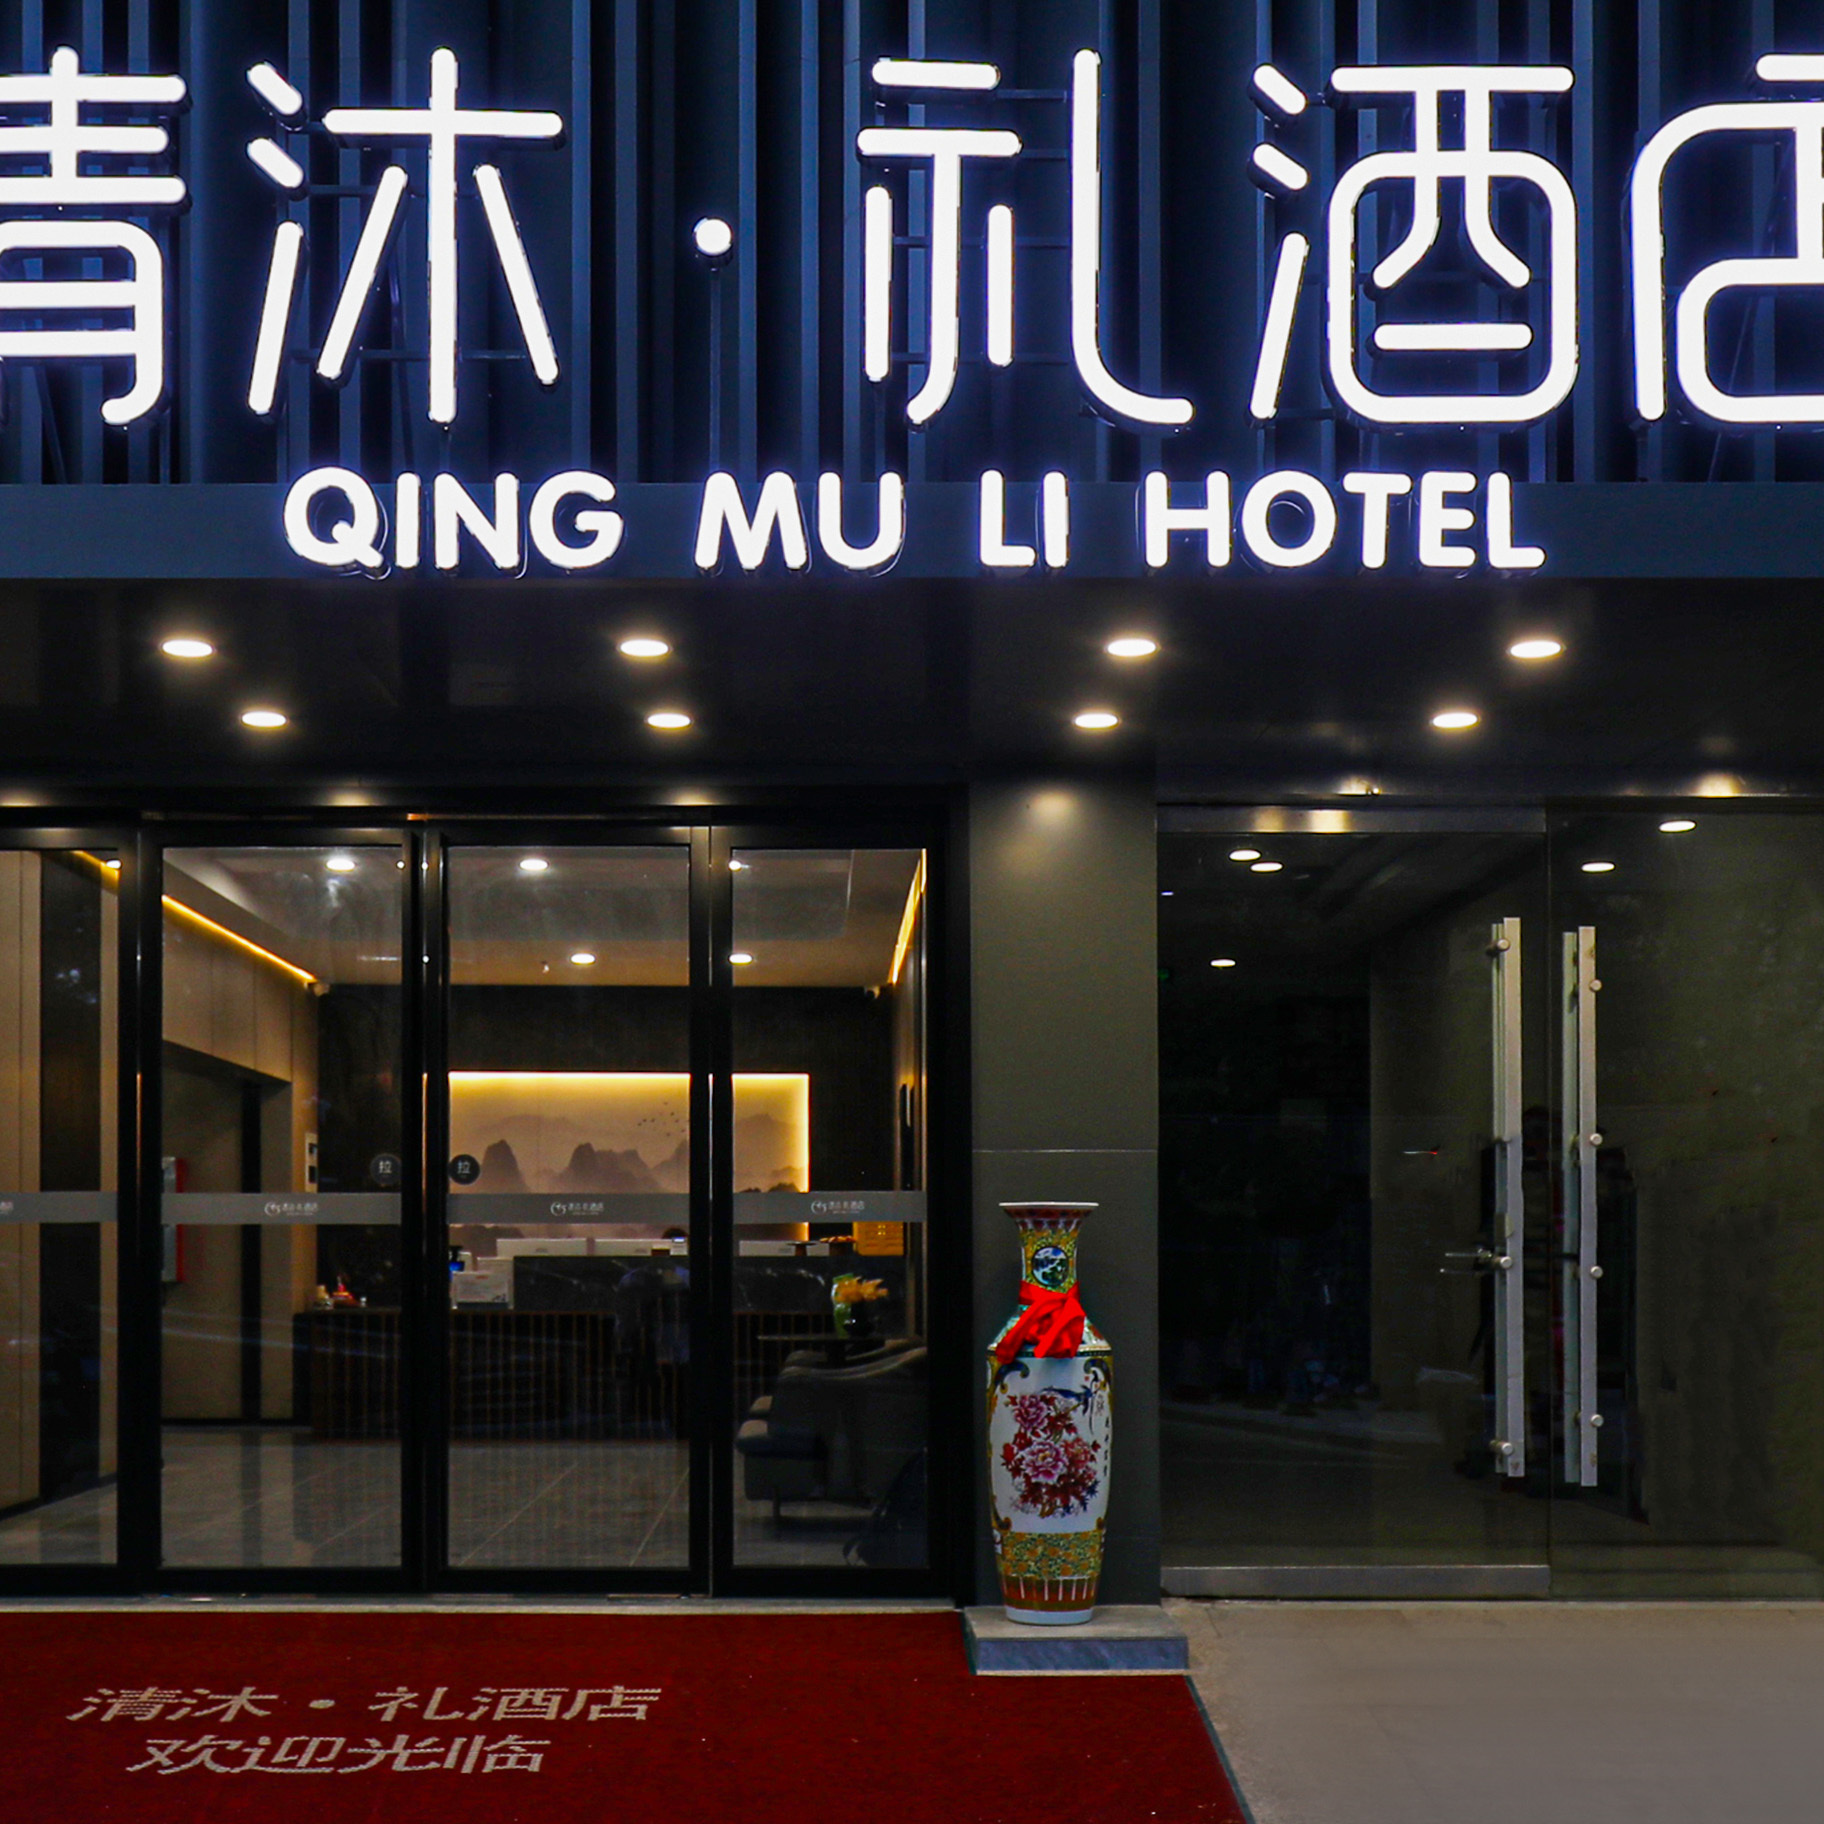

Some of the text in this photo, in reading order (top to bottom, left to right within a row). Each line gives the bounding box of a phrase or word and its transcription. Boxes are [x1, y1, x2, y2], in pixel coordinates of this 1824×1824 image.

[283, 466, 1546, 572] QING MU LI HOTEL
[125, 1733, 551, 1775] 欢迎光临
